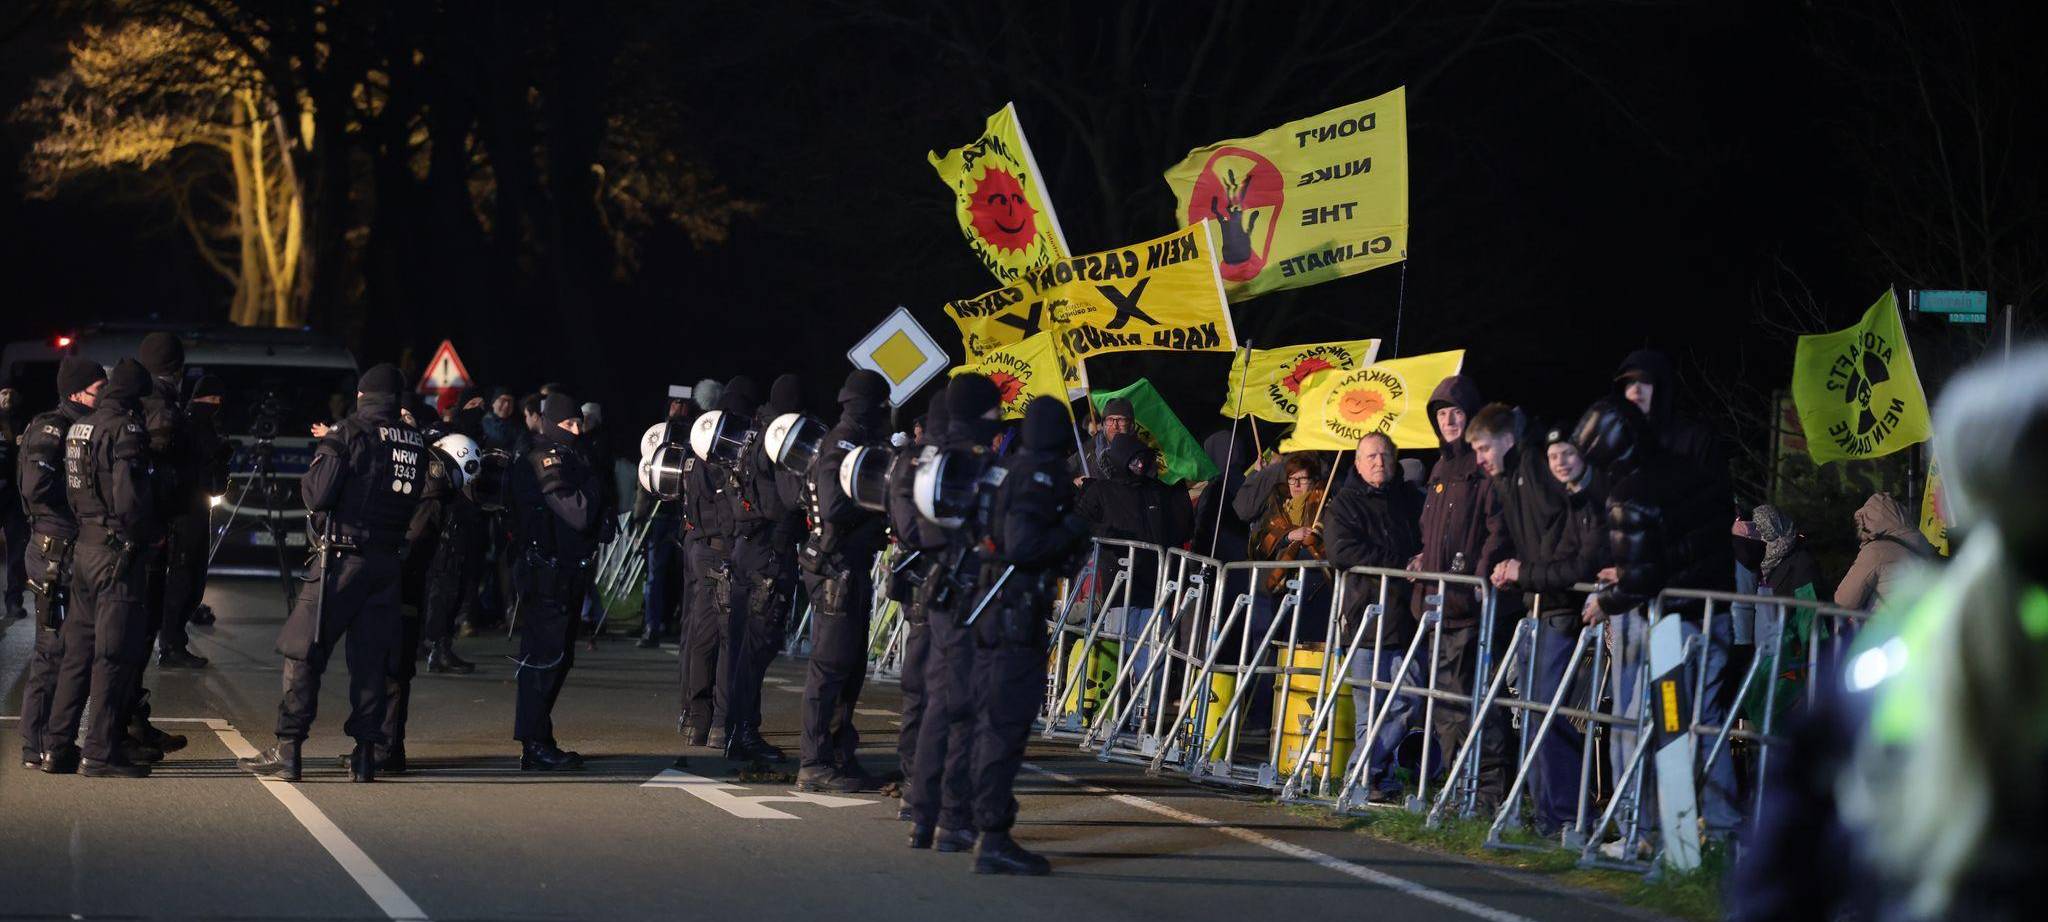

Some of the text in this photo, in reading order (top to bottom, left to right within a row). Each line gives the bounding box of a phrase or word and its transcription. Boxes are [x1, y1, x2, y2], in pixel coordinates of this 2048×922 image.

[379, 426, 424, 448] POLIZEI
[392, 448, 418, 466] NRW
[393, 464, 416, 480] 1343
